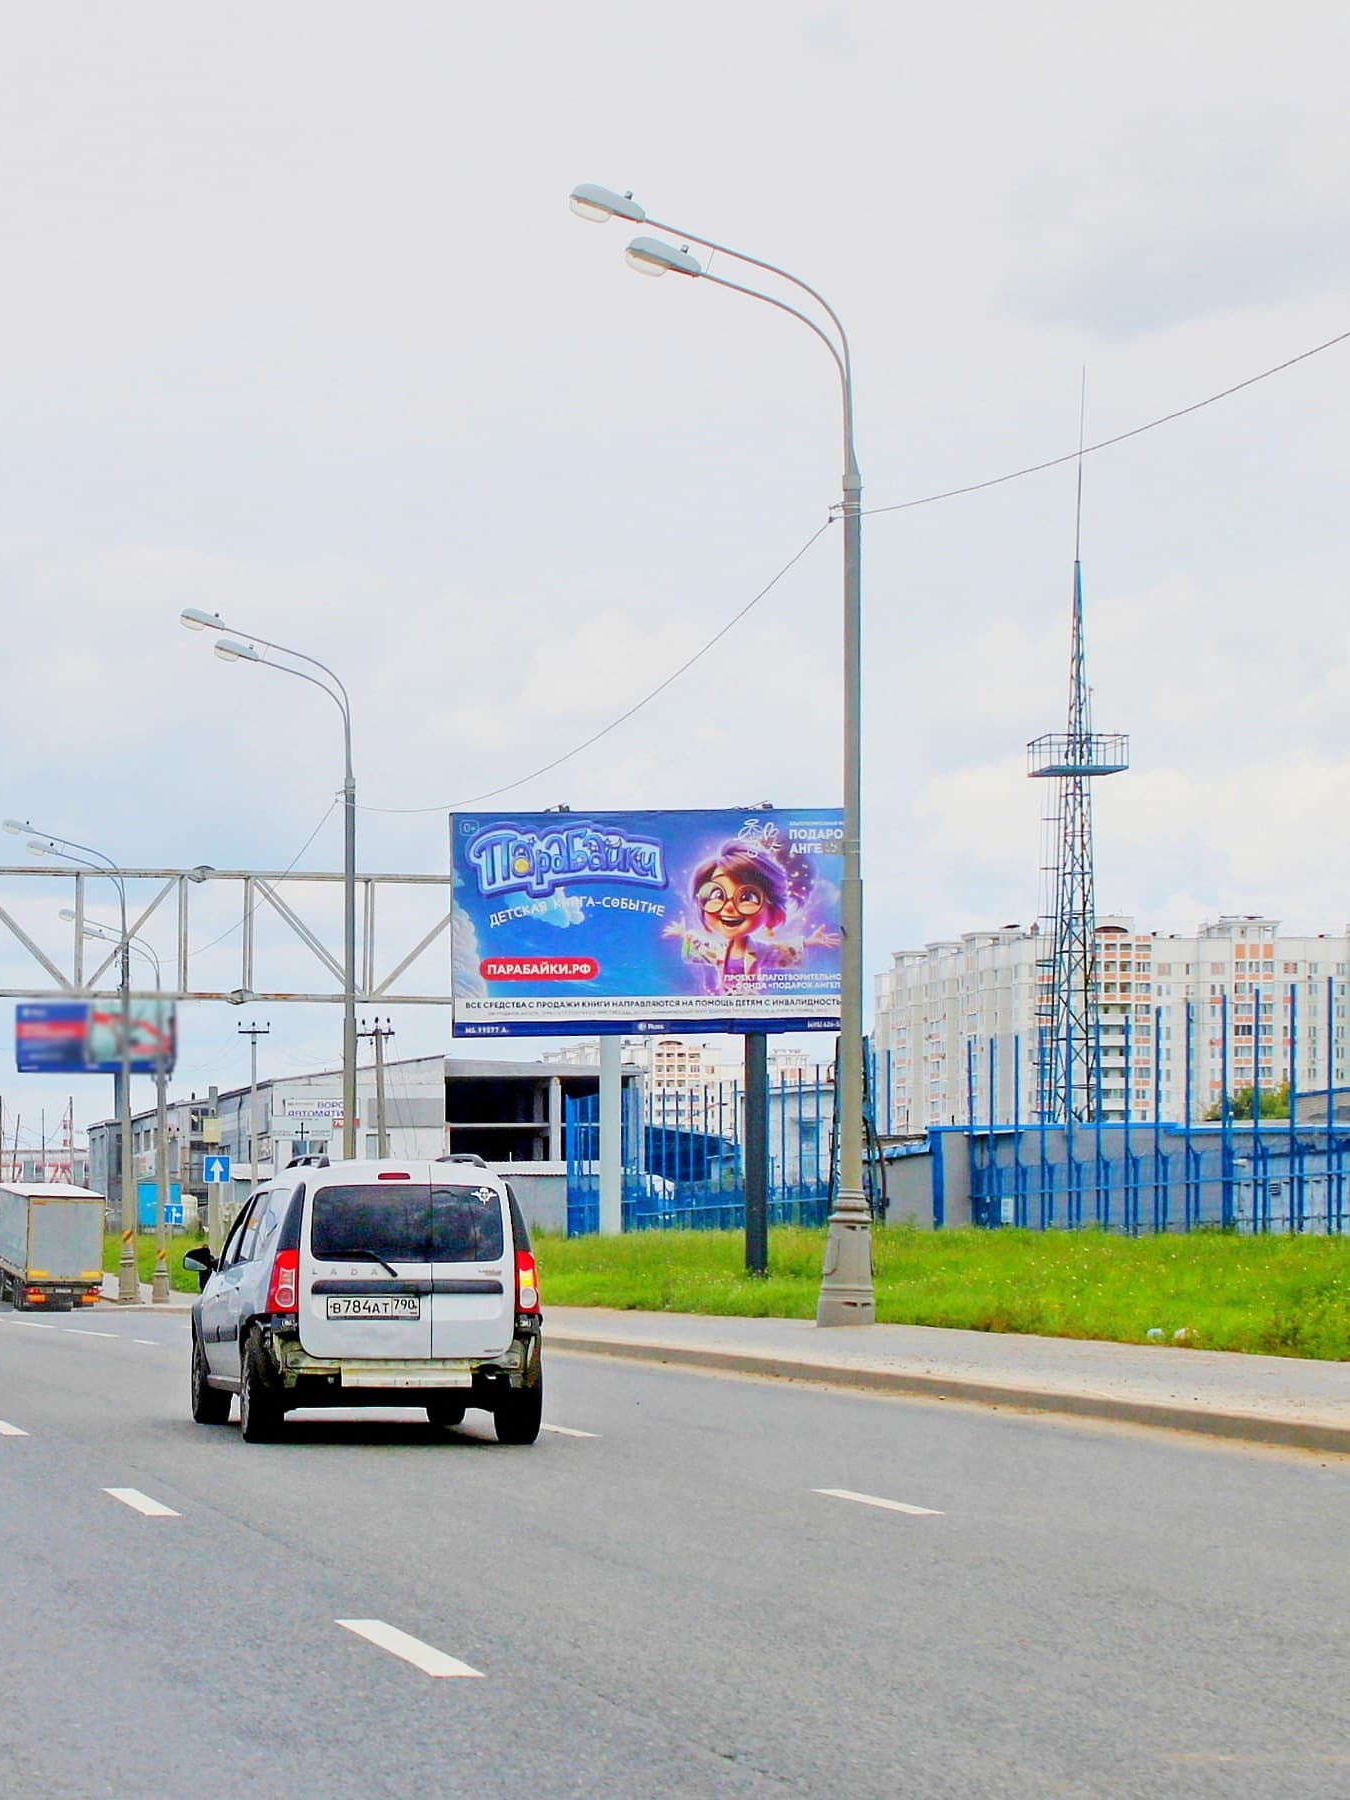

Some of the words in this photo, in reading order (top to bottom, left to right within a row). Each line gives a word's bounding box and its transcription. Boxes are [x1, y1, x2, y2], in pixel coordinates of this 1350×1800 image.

[789, 828, 843, 840] ПОДАРО
[789, 843, 827, 854] АНГЕ
[489, 902, 547, 929] ДЕТСКАЯ
[487, 960, 591, 975] ПАРАБАЙКИ.РФ
[465, 1001, 481, 1009] ВСЕ
[483, 1001, 527, 1009] СРЕДСТВА
[536, 1001, 580, 1009] ПРОДАЖИ
[582, 1000, 610, 1008] КНИГИ
[612, 999, 680, 1008] НАПРАВЛЯЮТСЯ
[695, 999, 734, 1008] ПОМОЩЬ
[735, 999, 762, 1007] ДЕТЯМ
[772, 998, 841, 1006] ИНВАЛИДНОСТЬ
[312, 1268, 378, 1276] LADA
[332, 1299, 390, 1314] В784АТ
[393, 1298, 416, 1311] 790
